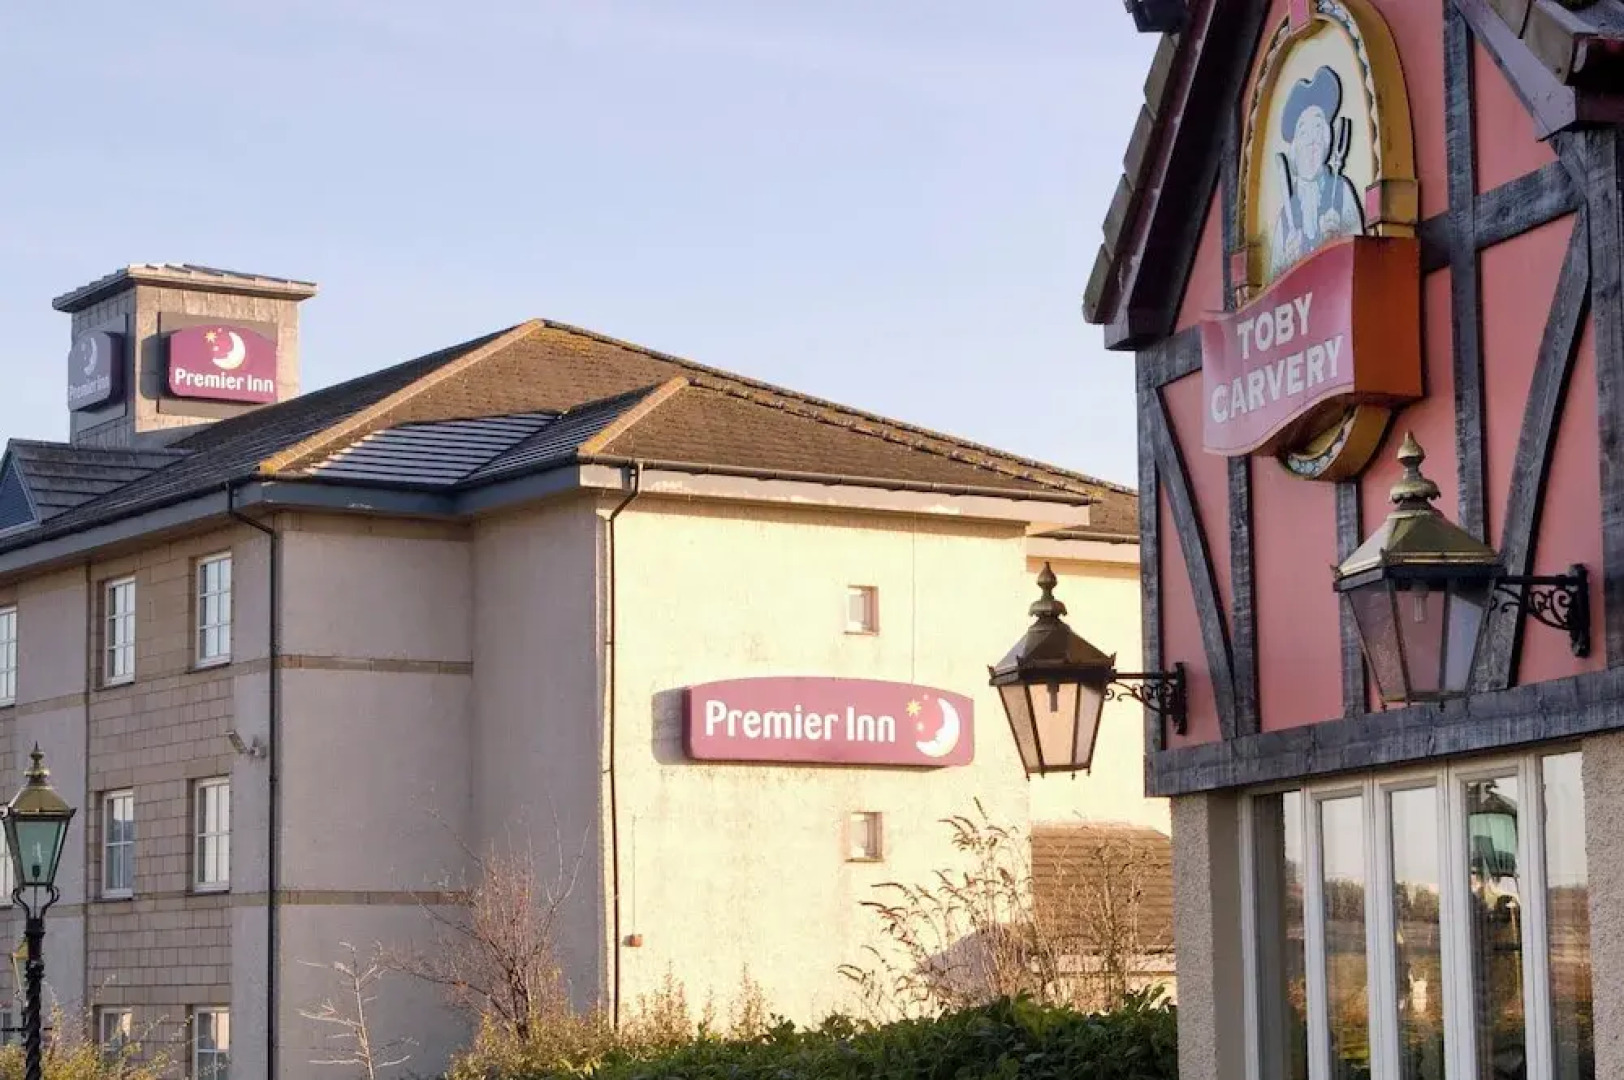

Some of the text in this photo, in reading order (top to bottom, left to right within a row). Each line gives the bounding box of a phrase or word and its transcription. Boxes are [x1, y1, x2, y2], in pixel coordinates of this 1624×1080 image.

[1237, 292, 1313, 360] TOBY
[175, 368, 273, 393] Premier Inn
[1211, 335, 1343, 423] CARVERY
[705, 700, 895, 743] Premier Inn
